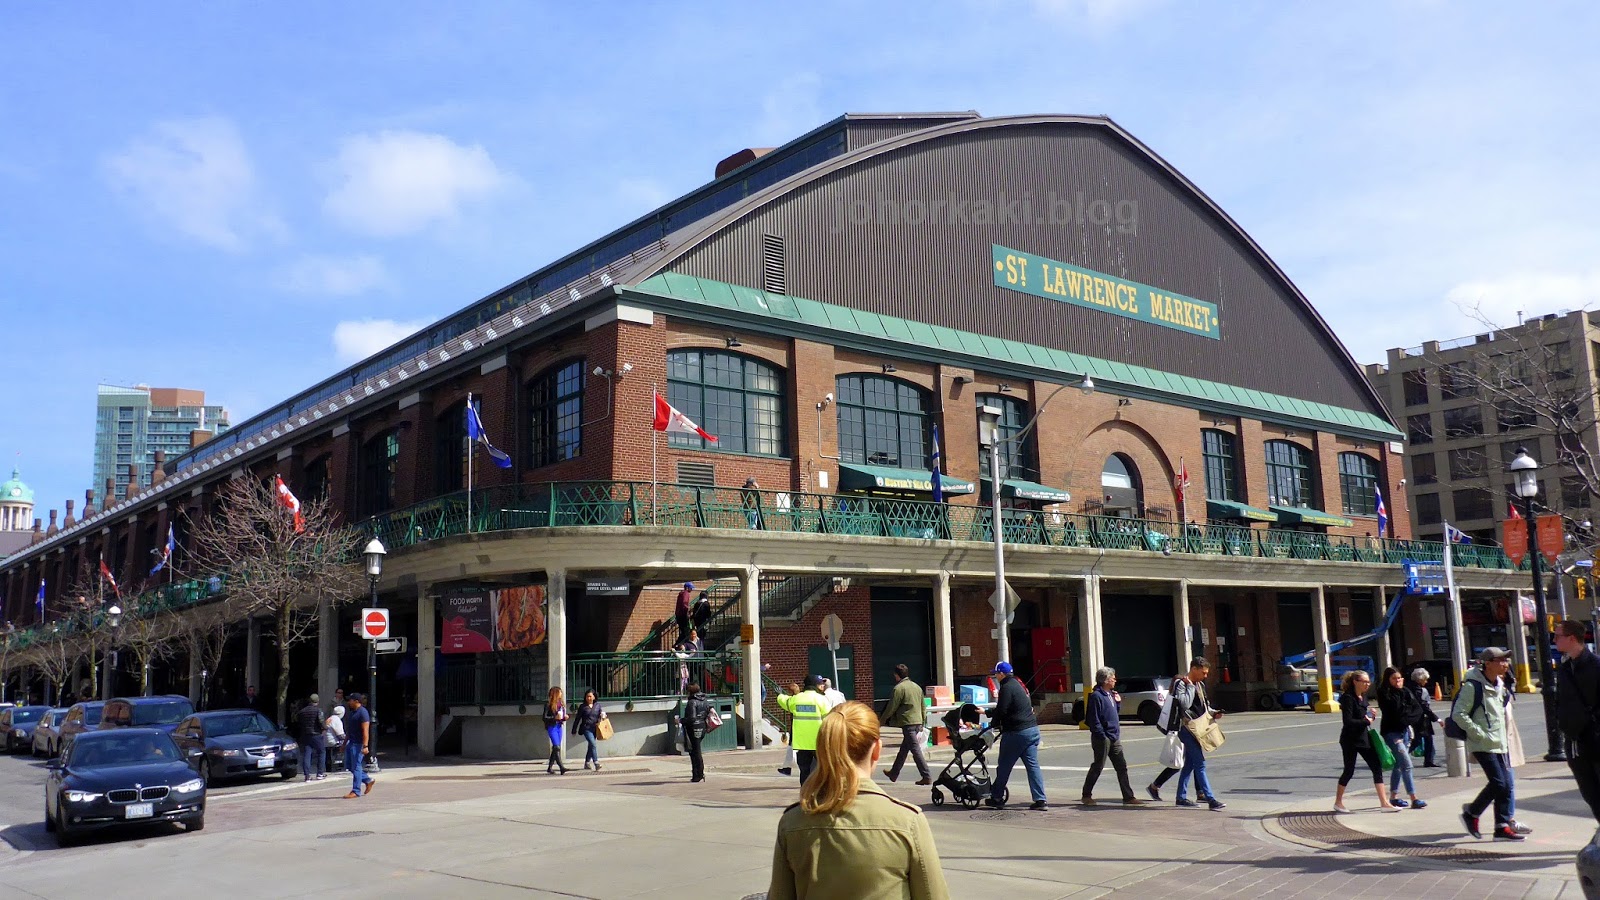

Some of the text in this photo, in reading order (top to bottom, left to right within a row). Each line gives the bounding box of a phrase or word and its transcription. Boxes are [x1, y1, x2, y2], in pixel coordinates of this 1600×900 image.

[1043, 263, 1139, 314] LAWRENCE
[1150, 292, 1211, 333] MARKET
[449, 596, 483, 606] FOOD WORTH
